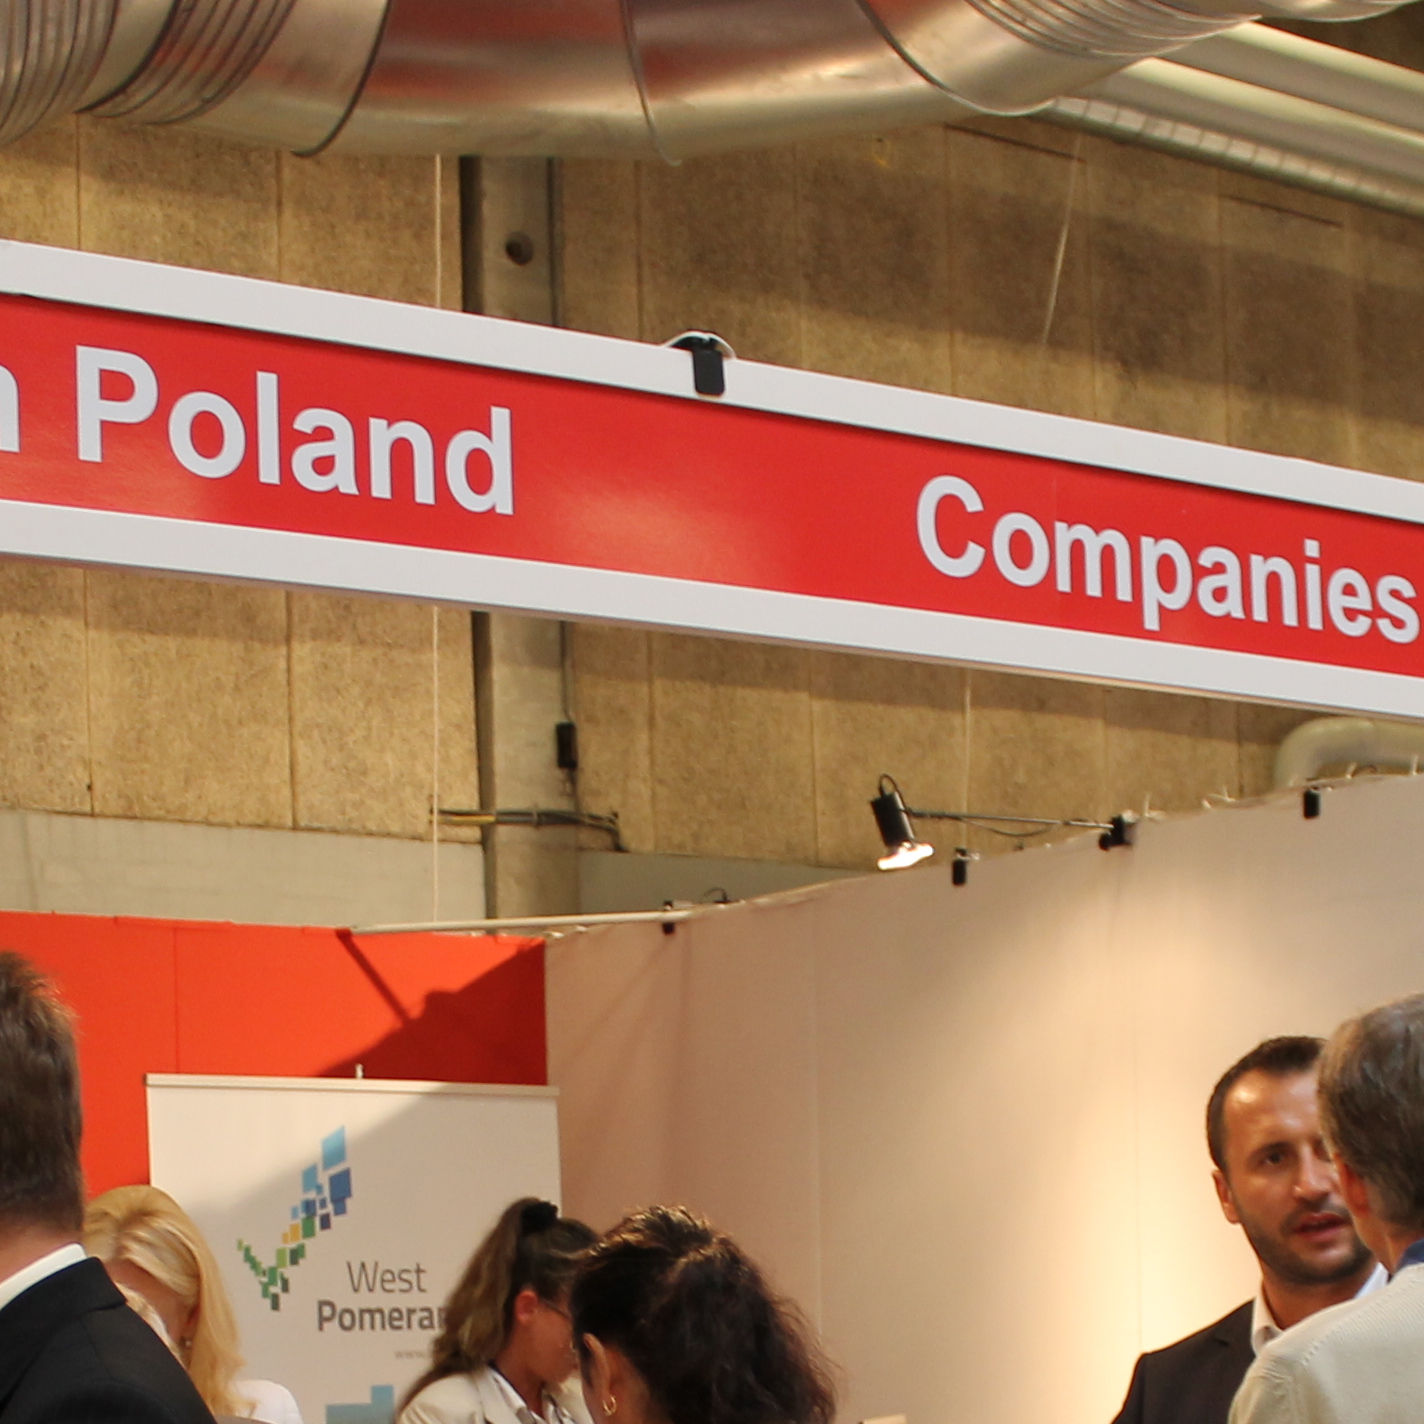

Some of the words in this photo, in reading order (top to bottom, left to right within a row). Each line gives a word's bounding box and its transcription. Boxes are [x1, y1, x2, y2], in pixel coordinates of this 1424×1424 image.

[74, 344, 514, 516] Poland
[915, 473, 1421, 645] Companies
[347, 1260, 427, 1293] West
